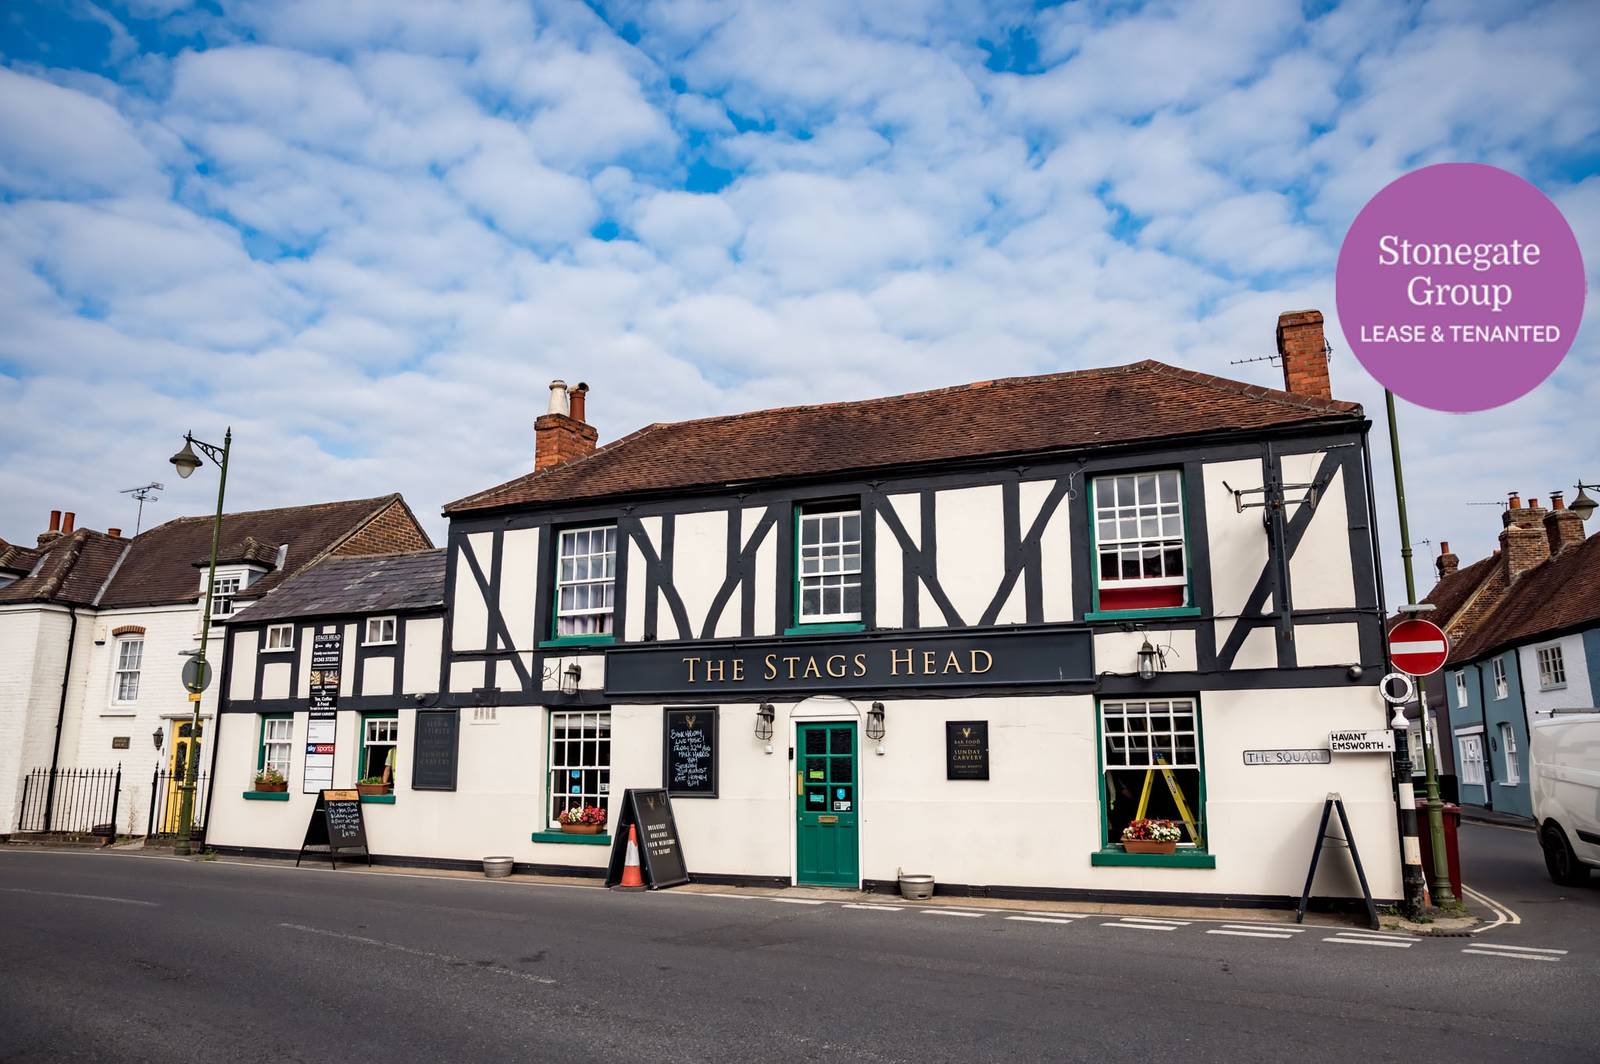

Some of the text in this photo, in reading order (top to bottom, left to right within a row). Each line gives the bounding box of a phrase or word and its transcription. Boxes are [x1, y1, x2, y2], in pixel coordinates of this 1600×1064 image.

[683, 648, 993, 683] THE STAGS HEAD
[1331, 733, 1367, 741] HAVANT
[1332, 742, 1384, 750] EMSWORTH
[1247, 753, 1271, 763] THE
